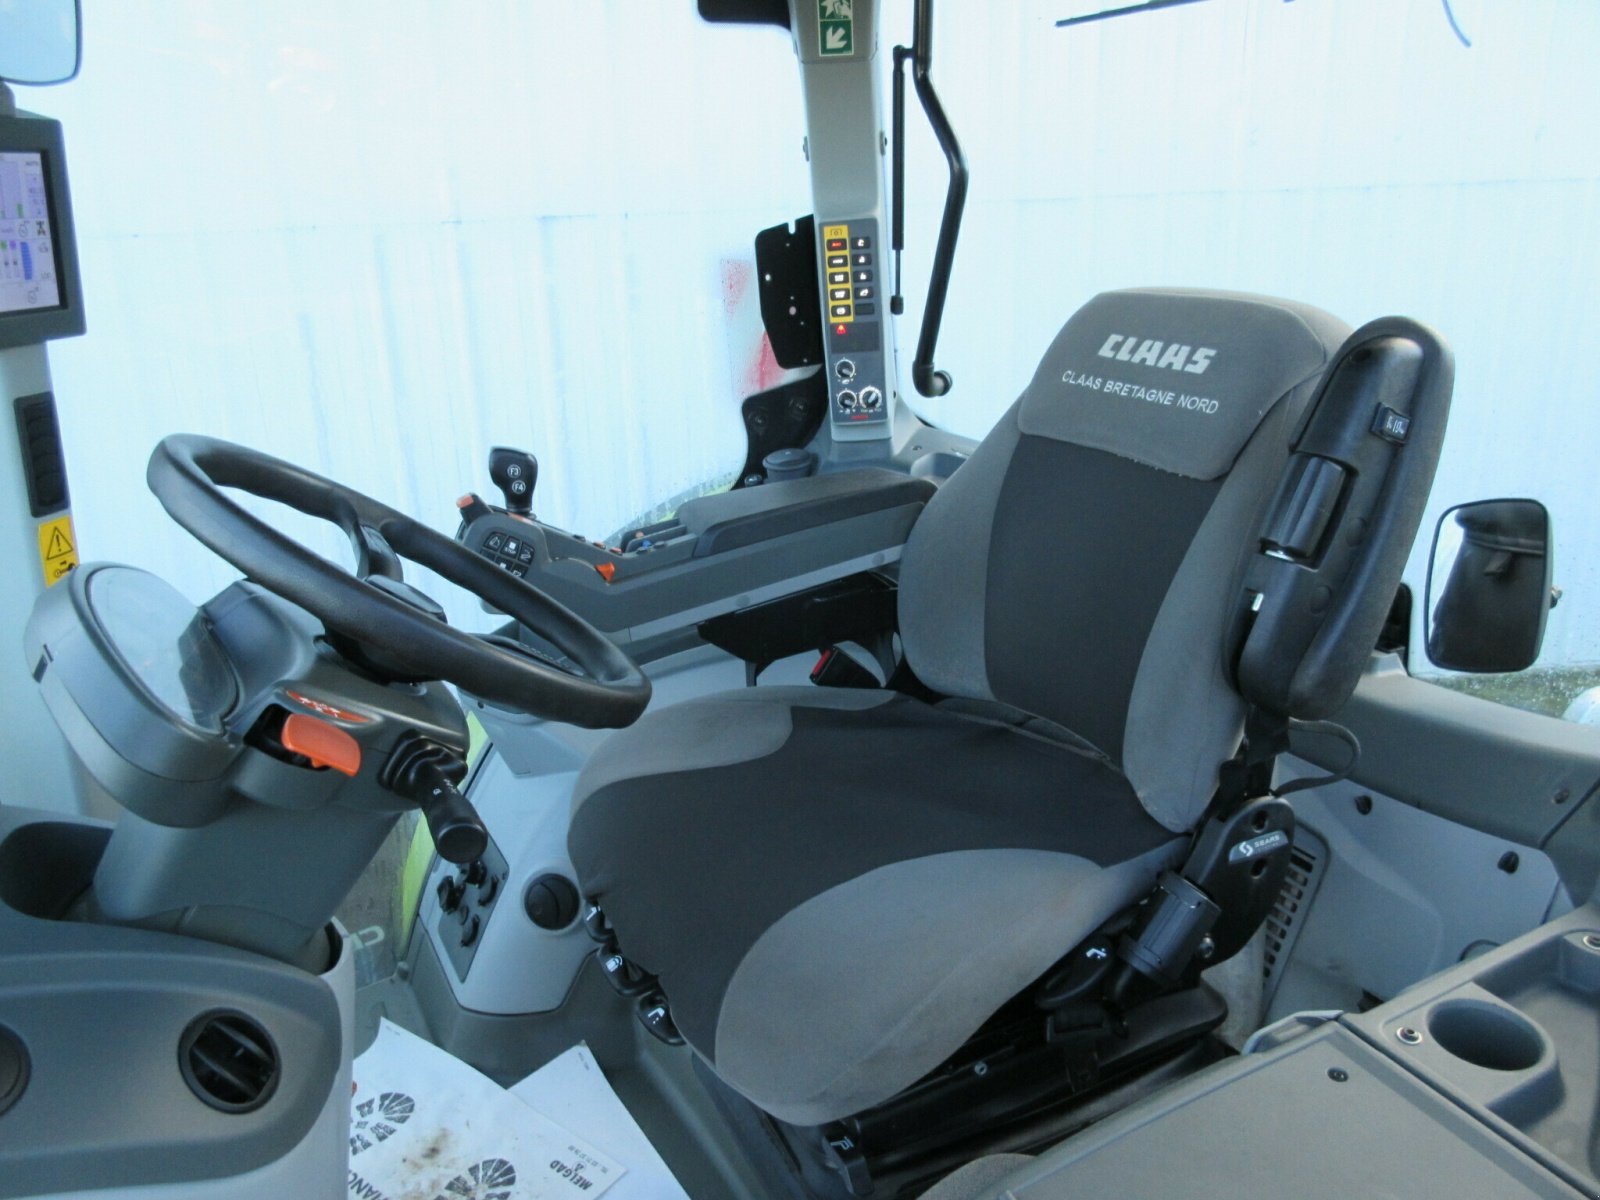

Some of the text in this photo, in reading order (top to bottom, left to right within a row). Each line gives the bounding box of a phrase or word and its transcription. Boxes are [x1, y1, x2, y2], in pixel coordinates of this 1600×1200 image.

[1098, 333, 1217, 374] CLAAS
[1062, 370, 1220, 415] CLAAS BRETAGNE NORD
[510, 467, 519, 476] F3
[514, 483, 524, 492] F4
[1254, 834, 1280, 847] SEARS
[549, 1159, 593, 1190] MELGAD
